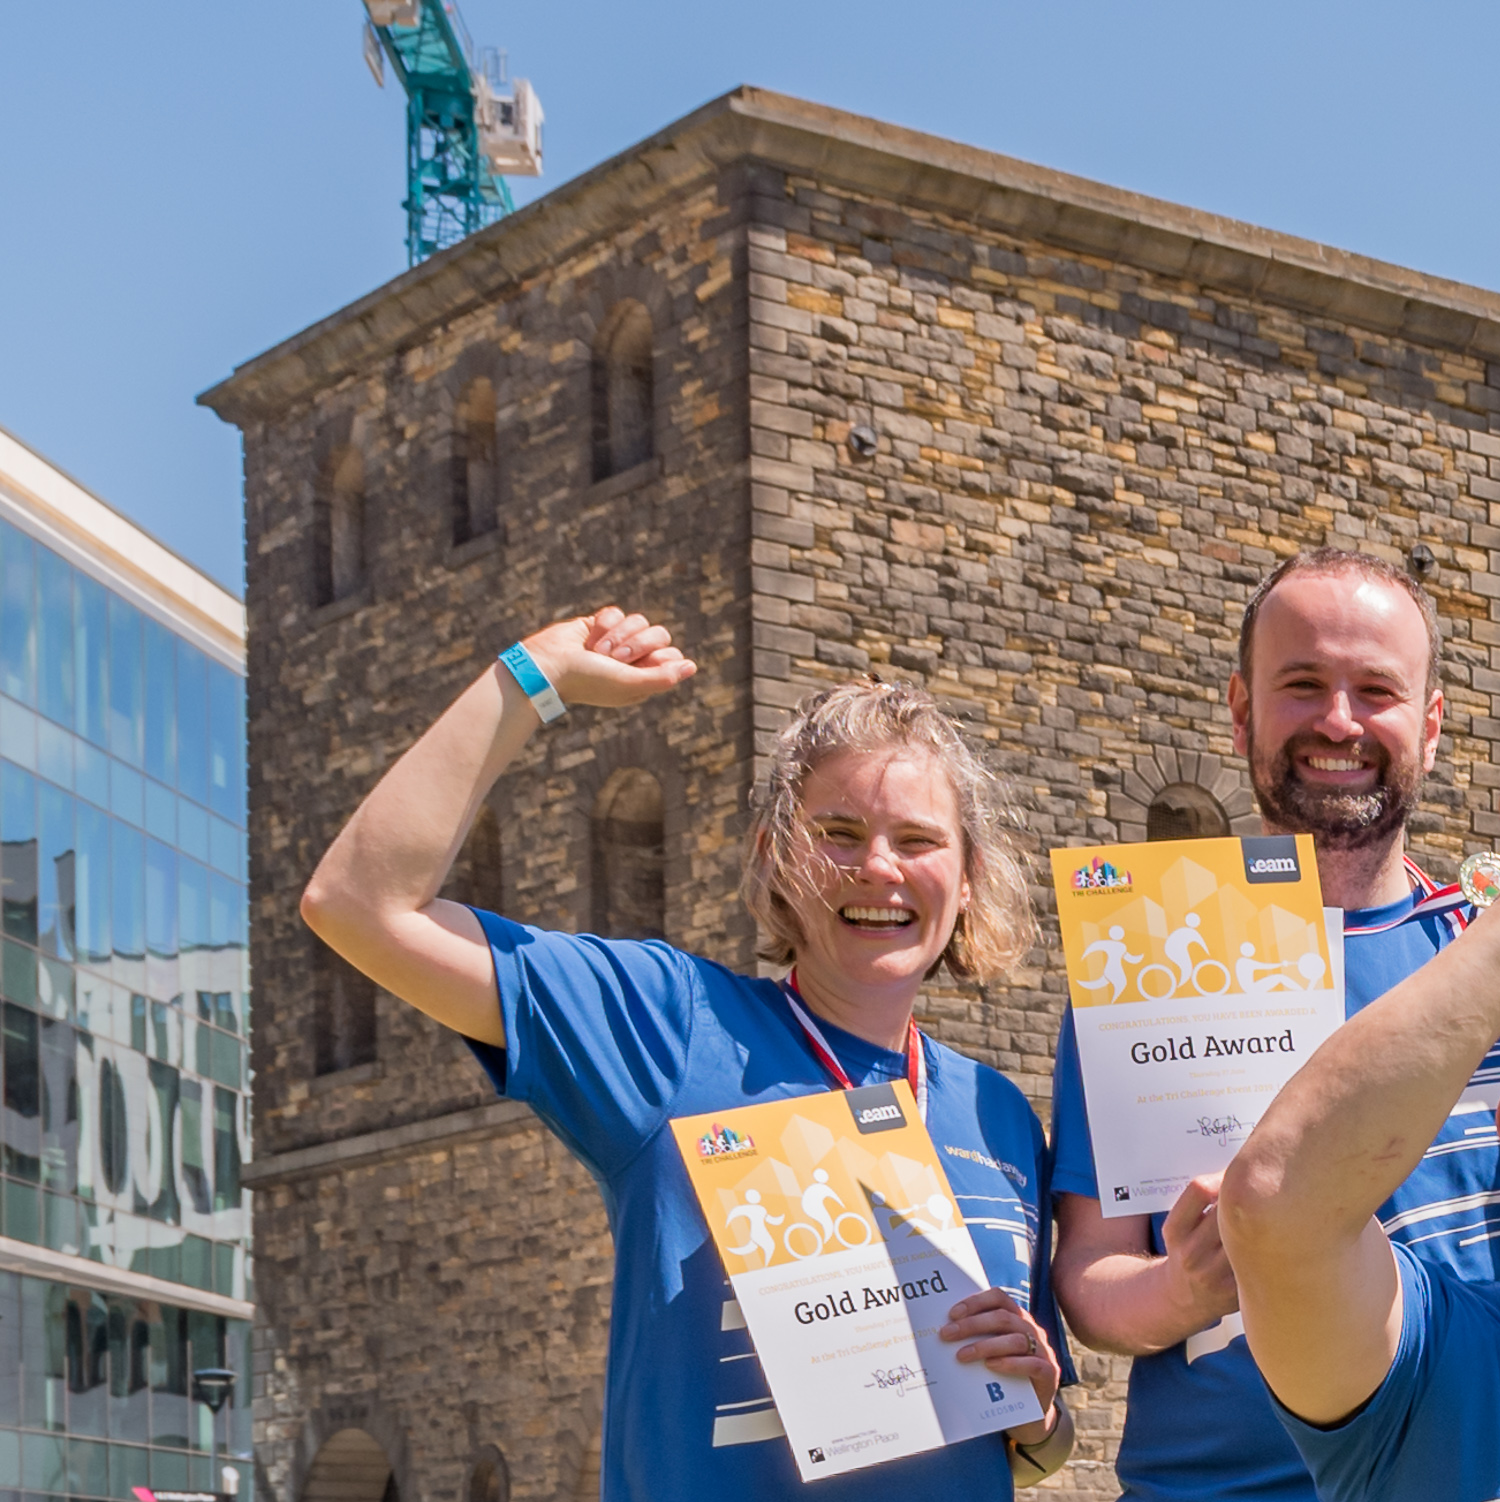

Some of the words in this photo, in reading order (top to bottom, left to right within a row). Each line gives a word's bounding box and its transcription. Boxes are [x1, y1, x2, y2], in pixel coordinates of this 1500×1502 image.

[1086, 887, 1133, 896] CHALLENGE
[1192, 1014, 1211, 1022] YOU
[1212, 1012, 1238, 1021] HAVE
[1239, 1010, 1262, 1019] BEEN
[1264, 1008, 1309, 1017] AWARDED
[1131, 1036, 1197, 1065] Gold
[1203, 1029, 1296, 1058] Award
[1148, 1093, 1163, 1102] the
[1165, 1092, 1178, 1101] Tri
[1180, 1088, 1226, 1100] Challenge
[1227, 1086, 1252, 1095] Event
[714, 1149, 758, 1164] CHALLENGE
[794, 1290, 858, 1325] Gold
[862, 1270, 949, 1311] Award
[822, 1352, 836, 1363] the
[836, 1349, 850, 1359] Tri
[850, 1338, 893, 1356] Challenge
[826, 1434, 873, 1457] Wellington
[874, 1432, 900, 1445] Place
